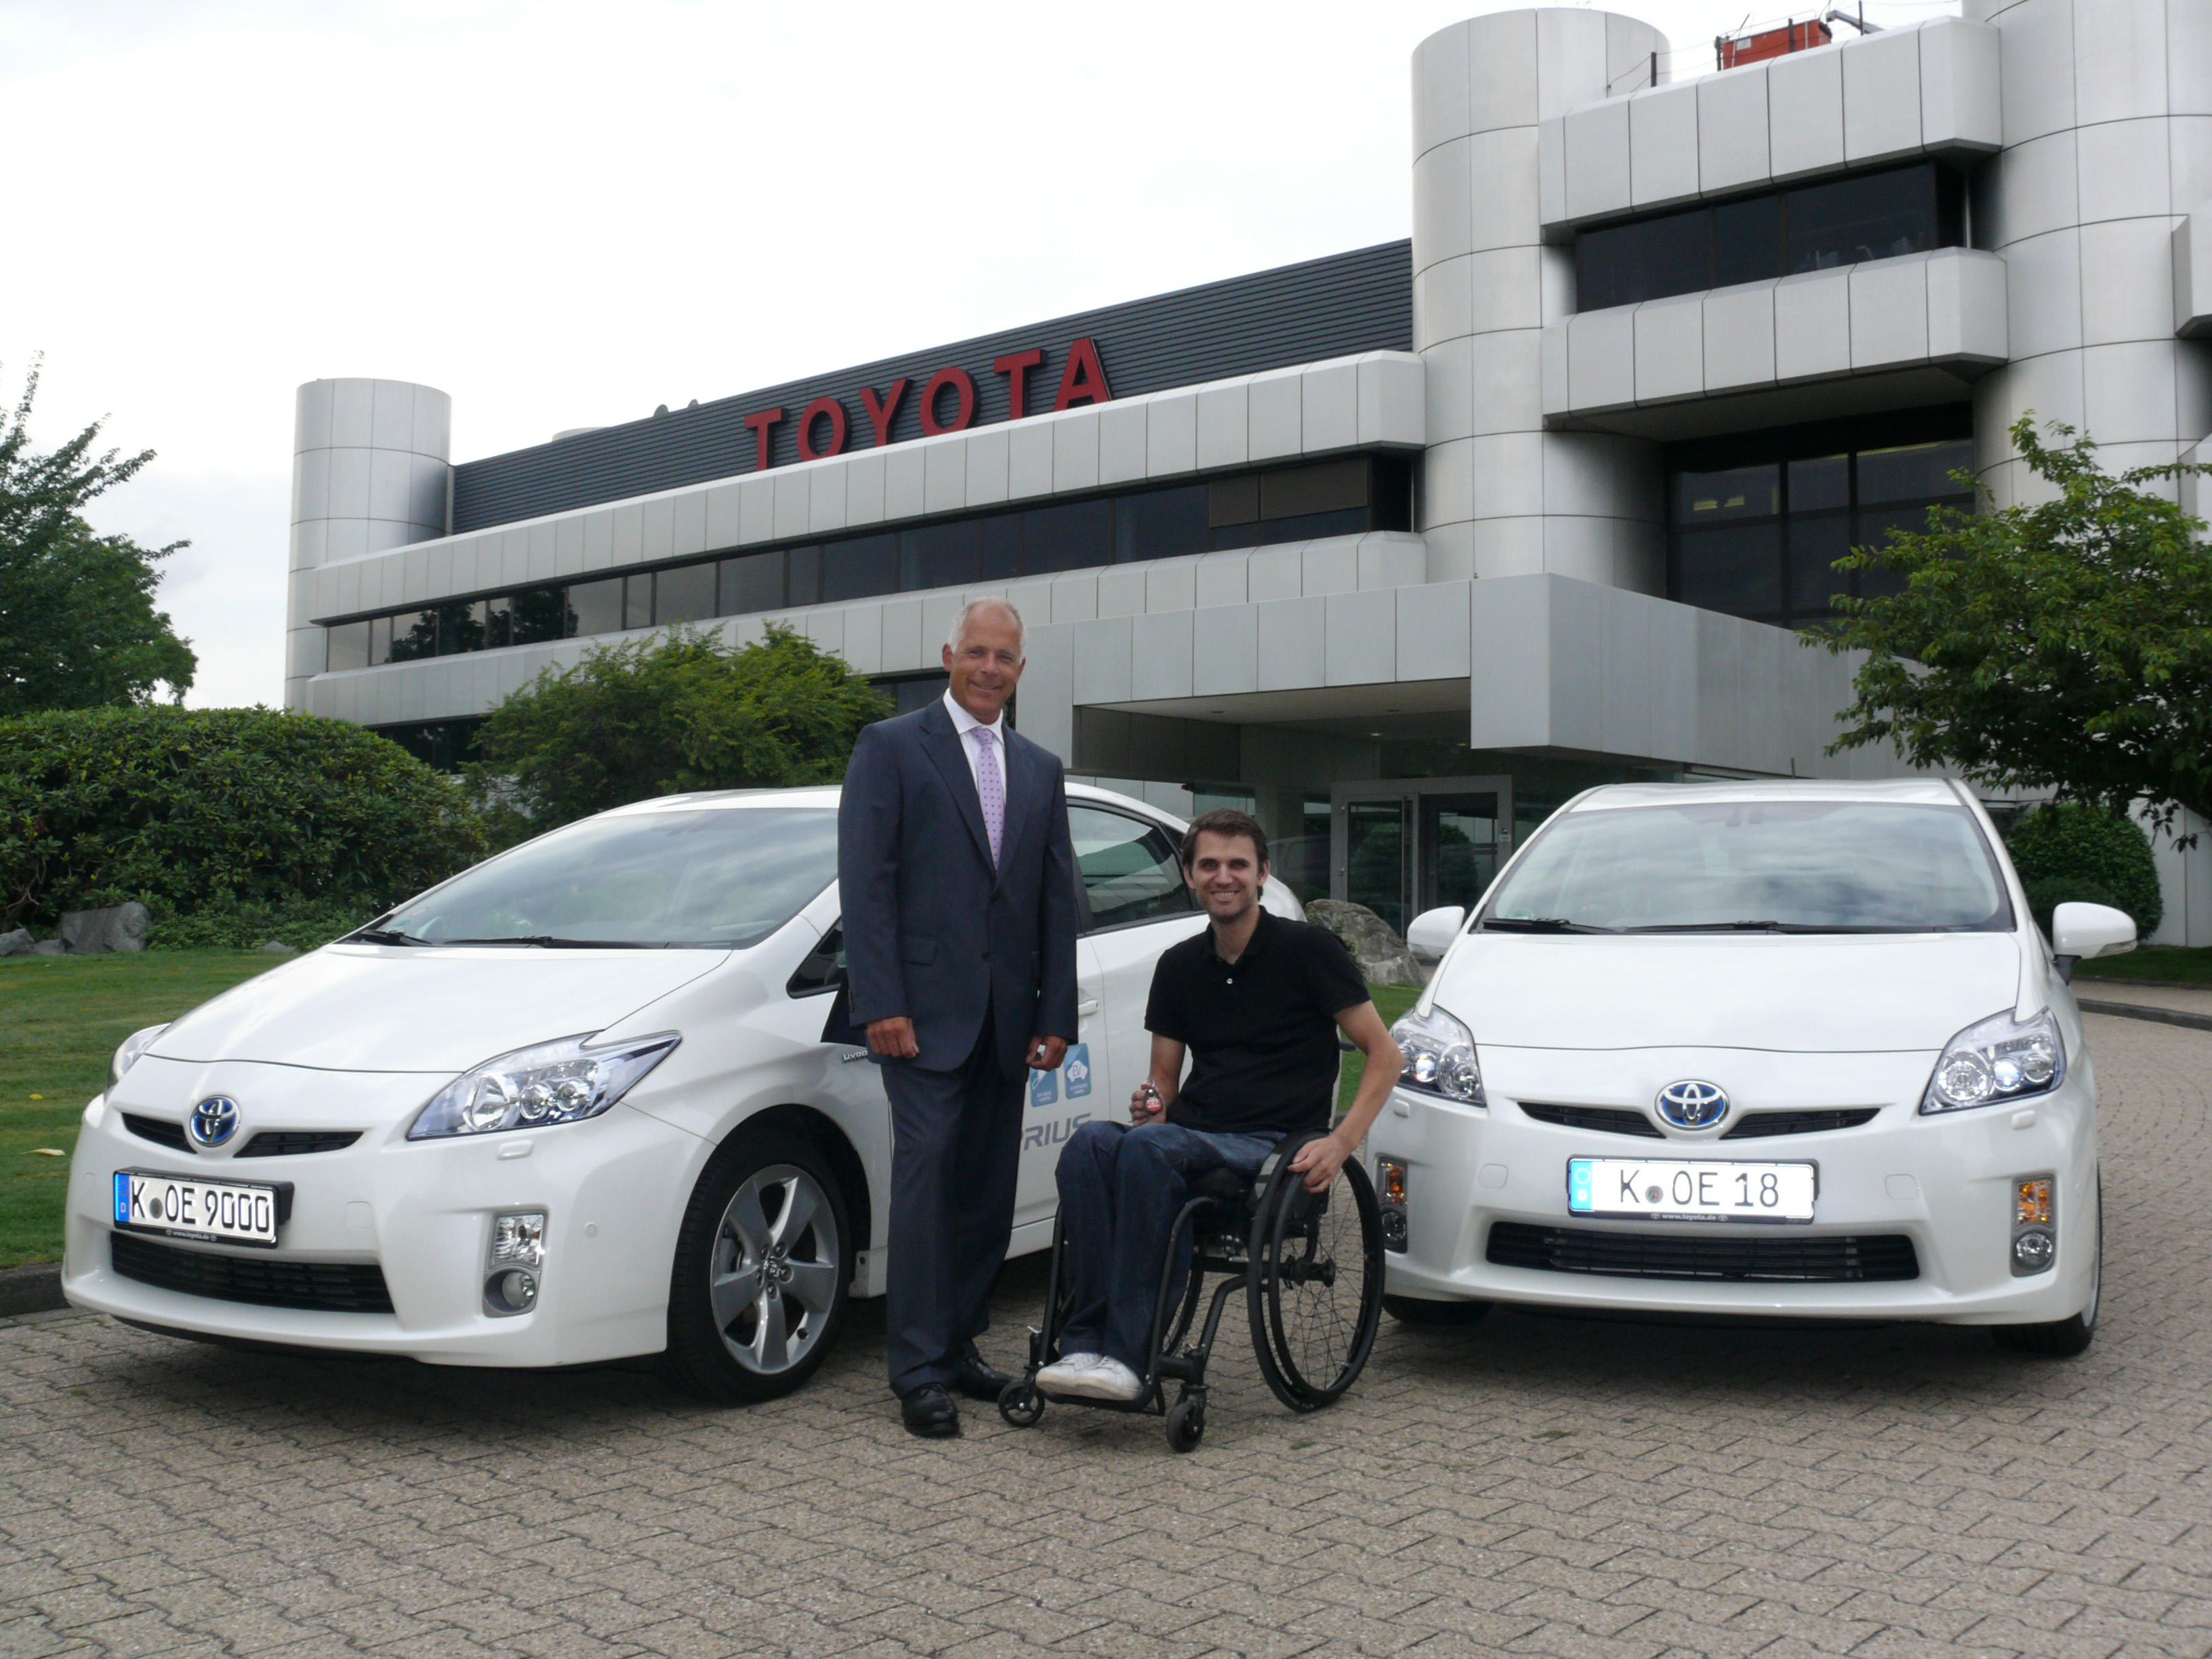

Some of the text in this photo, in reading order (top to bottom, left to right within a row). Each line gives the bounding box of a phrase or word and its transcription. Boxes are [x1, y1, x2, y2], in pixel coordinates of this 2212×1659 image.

[745, 338, 1113, 472] TOYOTA
[1022, 1113, 1092, 1151] RIUS
[120, 1202, 126, 1213] D
[131, 1181, 270, 1233] K OE 9000
[1578, 1189, 1588, 1201] D
[1620, 1169, 1780, 1208] K OE 18
